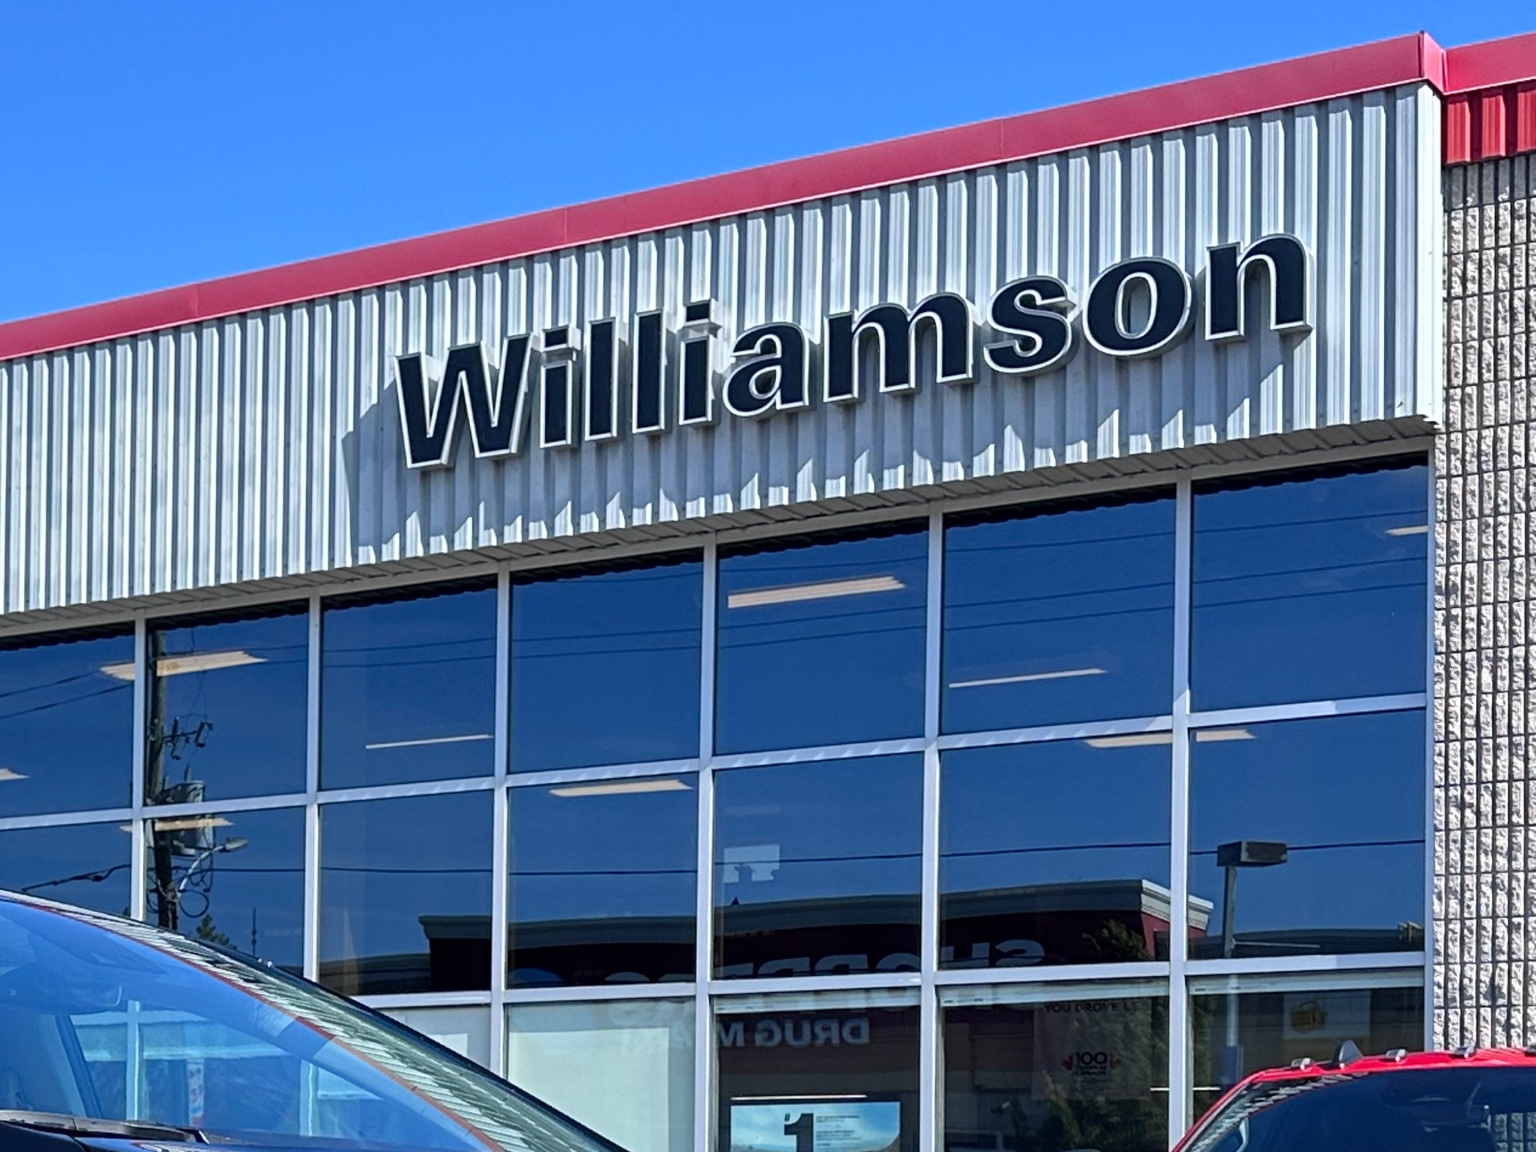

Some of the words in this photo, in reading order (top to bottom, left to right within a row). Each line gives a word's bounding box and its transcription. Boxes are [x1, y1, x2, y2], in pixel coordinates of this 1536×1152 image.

[393, 233, 1313, 470] Williamson
[1044, 1002, 1071, 1013] YOU
[1075, 1002, 1119, 1013] DROVE
[1075, 1051, 1109, 1066] 100
